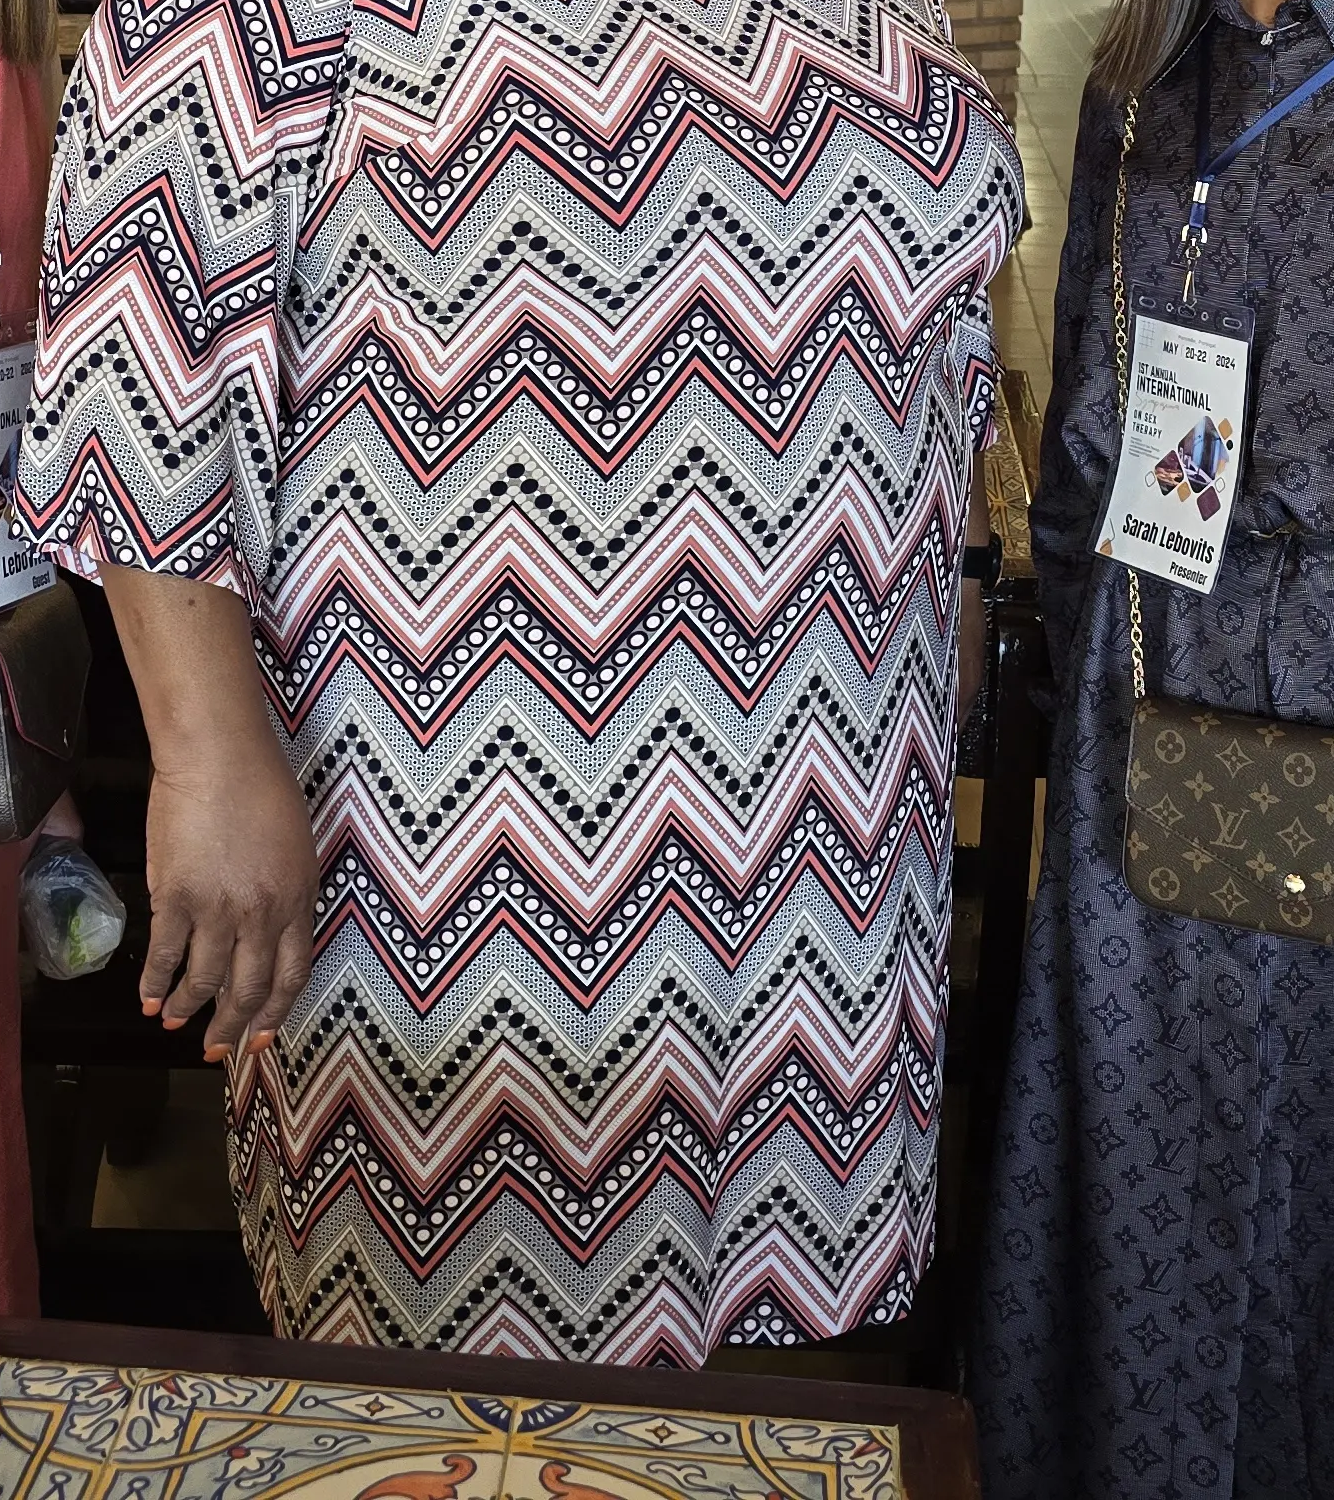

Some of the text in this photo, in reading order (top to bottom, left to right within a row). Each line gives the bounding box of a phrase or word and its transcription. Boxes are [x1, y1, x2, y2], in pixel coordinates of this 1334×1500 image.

[1163, 340, 1179, 355] MAY
[1186, 347, 1207, 362] 20-22
[1216, 355, 1235, 370] 2024
[1138, 362, 1178, 384] 1ST ANNUAL
[1137, 375, 1212, 411] INTERNATIONAL
[1134, 409, 1157, 425] ON SEX
[1132, 422, 1162, 439] THERAPY
[1123, 513, 1214, 564] Sarah Lebovits
[32, 571, 50, 589] Guest
[1169, 561, 1208, 586] Presenter
